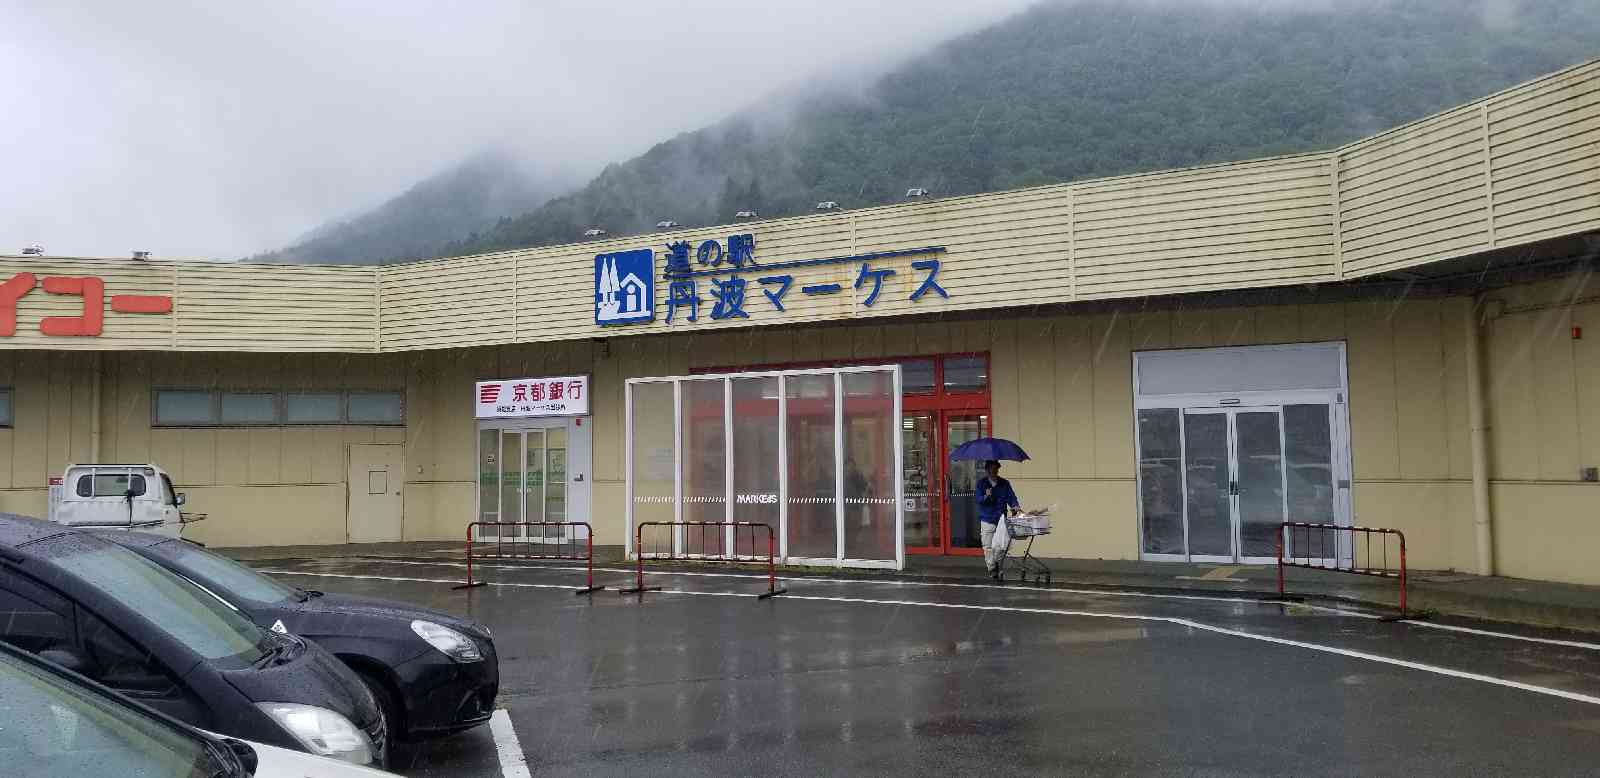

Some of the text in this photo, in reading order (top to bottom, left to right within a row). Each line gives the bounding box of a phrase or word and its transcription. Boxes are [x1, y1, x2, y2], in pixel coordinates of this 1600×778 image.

[664, 234, 755, 272] 道の駅
[664, 259, 949, 325] 丹波マーケス
[513, 380, 583, 402] 京都銀行
